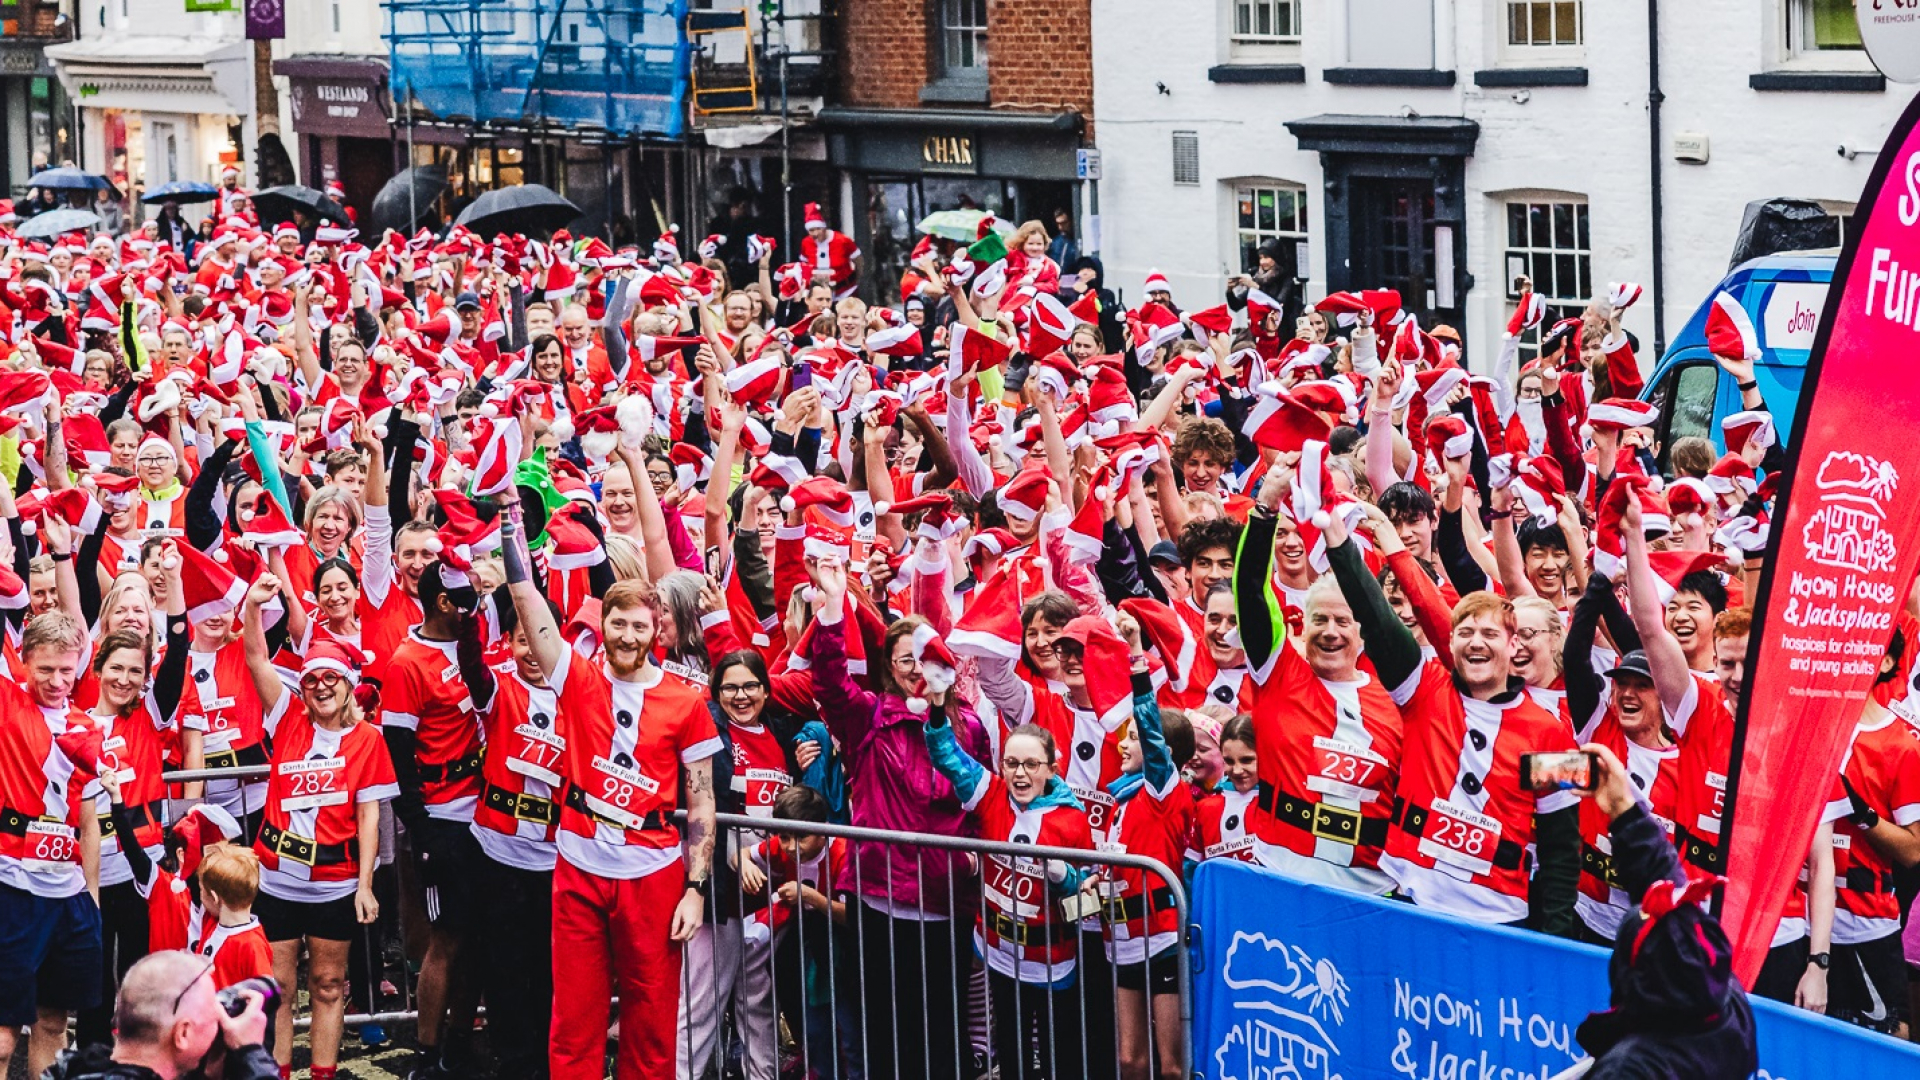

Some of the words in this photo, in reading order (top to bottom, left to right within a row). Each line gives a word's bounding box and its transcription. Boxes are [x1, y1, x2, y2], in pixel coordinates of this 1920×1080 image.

[1873, 14, 1915, 24] FREEHOUSE
[317, 86, 368, 102] WESTLANDS
[923, 135, 973, 166] CHAR
[1787, 301, 1816, 334] Join
[1790, 570, 1838, 599] Naomi
[1842, 574, 1896, 604] House
[1782, 597, 1800, 626] &
[1800, 602, 1892, 634] Jacksplace
[1781, 633, 1827, 655] hospices
[1828, 637, 1844, 655] for
[1843, 640, 1885, 657] children
[1789, 656, 1811, 671] and
[1810, 659, 1840, 677] young
[1841, 660, 1875, 676] adults
[519, 724, 541, 738] Santa
[542, 731, 557, 744] Fun
[519, 737, 561, 769] 717
[1319, 739, 1346, 751] Santa
[1348, 744, 1365, 756] Fun
[283, 763, 305, 772] Santa
[324, 759, 341, 768] Run
[597, 760, 619, 775] Santa
[619, 768, 637, 782] Fun
[750, 770, 772, 779] Santa
[1321, 751, 1376, 785] 237
[290, 770, 336, 796] 282
[602, 777, 634, 808] 98
[1710, 775, 1725, 786] San
[1087, 790, 1105, 802] Fun
[1435, 801, 1459, 816] Santa
[1460, 809, 1478, 823] Fun
[1479, 816, 1498, 830] Run
[1207, 845, 1225, 856] Santa
[1225, 840, 1242, 851] Fun
[1243, 836, 1256, 846] Ru
[1431, 816, 1486, 855] 238
[35, 836, 75, 861] 683
[992, 863, 1033, 901] 740
[1027, 864, 1045, 877] Run
[1394, 977, 1483, 1039] Naomi
[1499, 997, 1590, 1064] Hou
[1390, 1027, 1418, 1080] &
